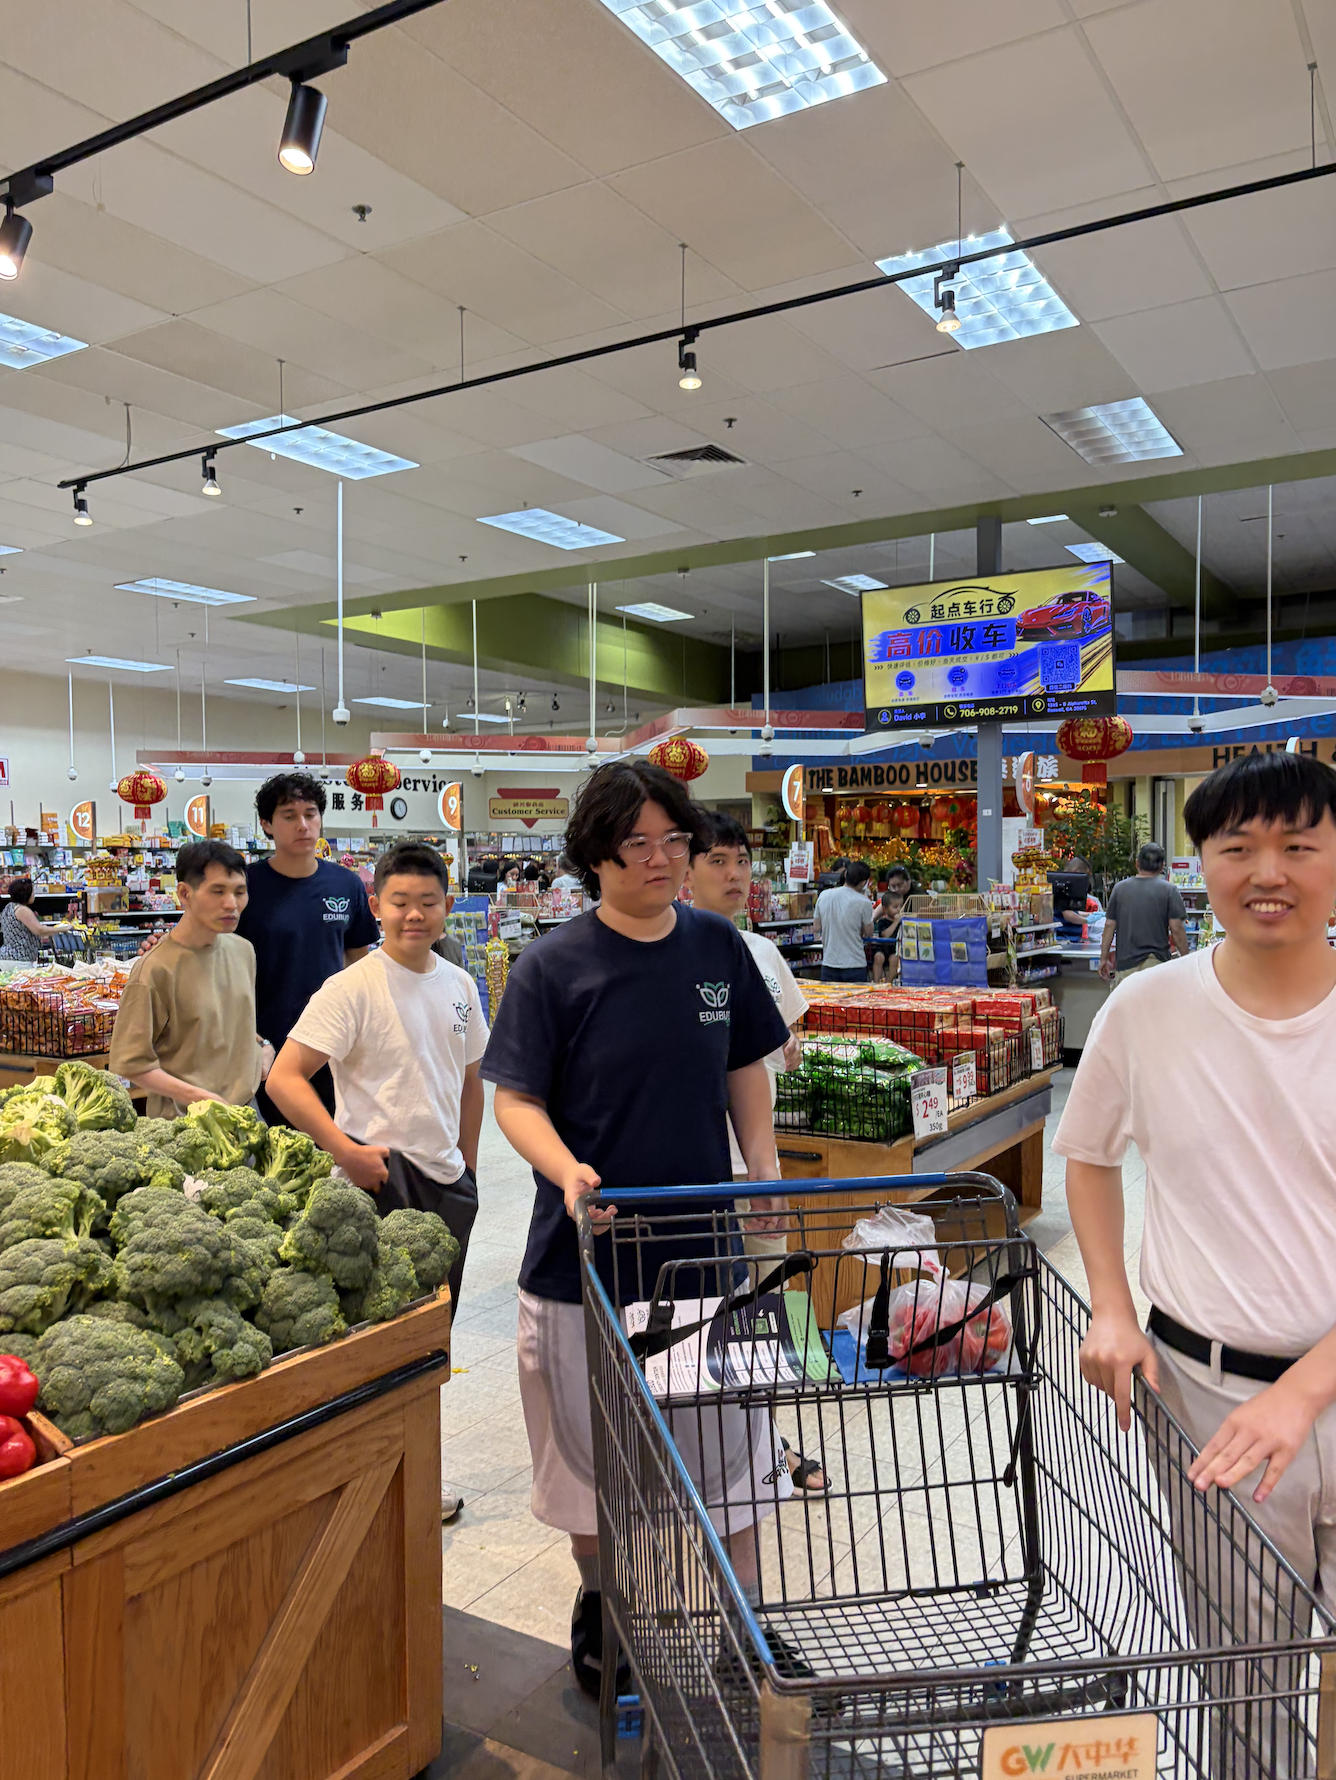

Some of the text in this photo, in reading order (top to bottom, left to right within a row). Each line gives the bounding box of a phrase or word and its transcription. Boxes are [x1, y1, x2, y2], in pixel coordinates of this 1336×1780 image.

[930, 599, 994, 619] 起点车行
[887, 623, 1007, 658] 高价收车
[893, 713, 912, 722] David
[959, 705, 1018, 718] 706-908-2719
[396, 774, 456, 793] ervic
[808, 769, 834, 789] THE
[837, 764, 910, 787] BAMBOO
[915, 760, 978, 785] HOUSE
[793, 781, 801, 802] 7
[332, 792, 364, 811] 服务
[448, 796, 458, 815] 9
[492, 807, 566, 815] Customer Service
[76, 812, 91, 828] 12
[192, 807, 204, 824] 11
[1001, 1742, 1056, 1777] GW
[1065, 1768, 1139, 1780] SUPERMARKET
